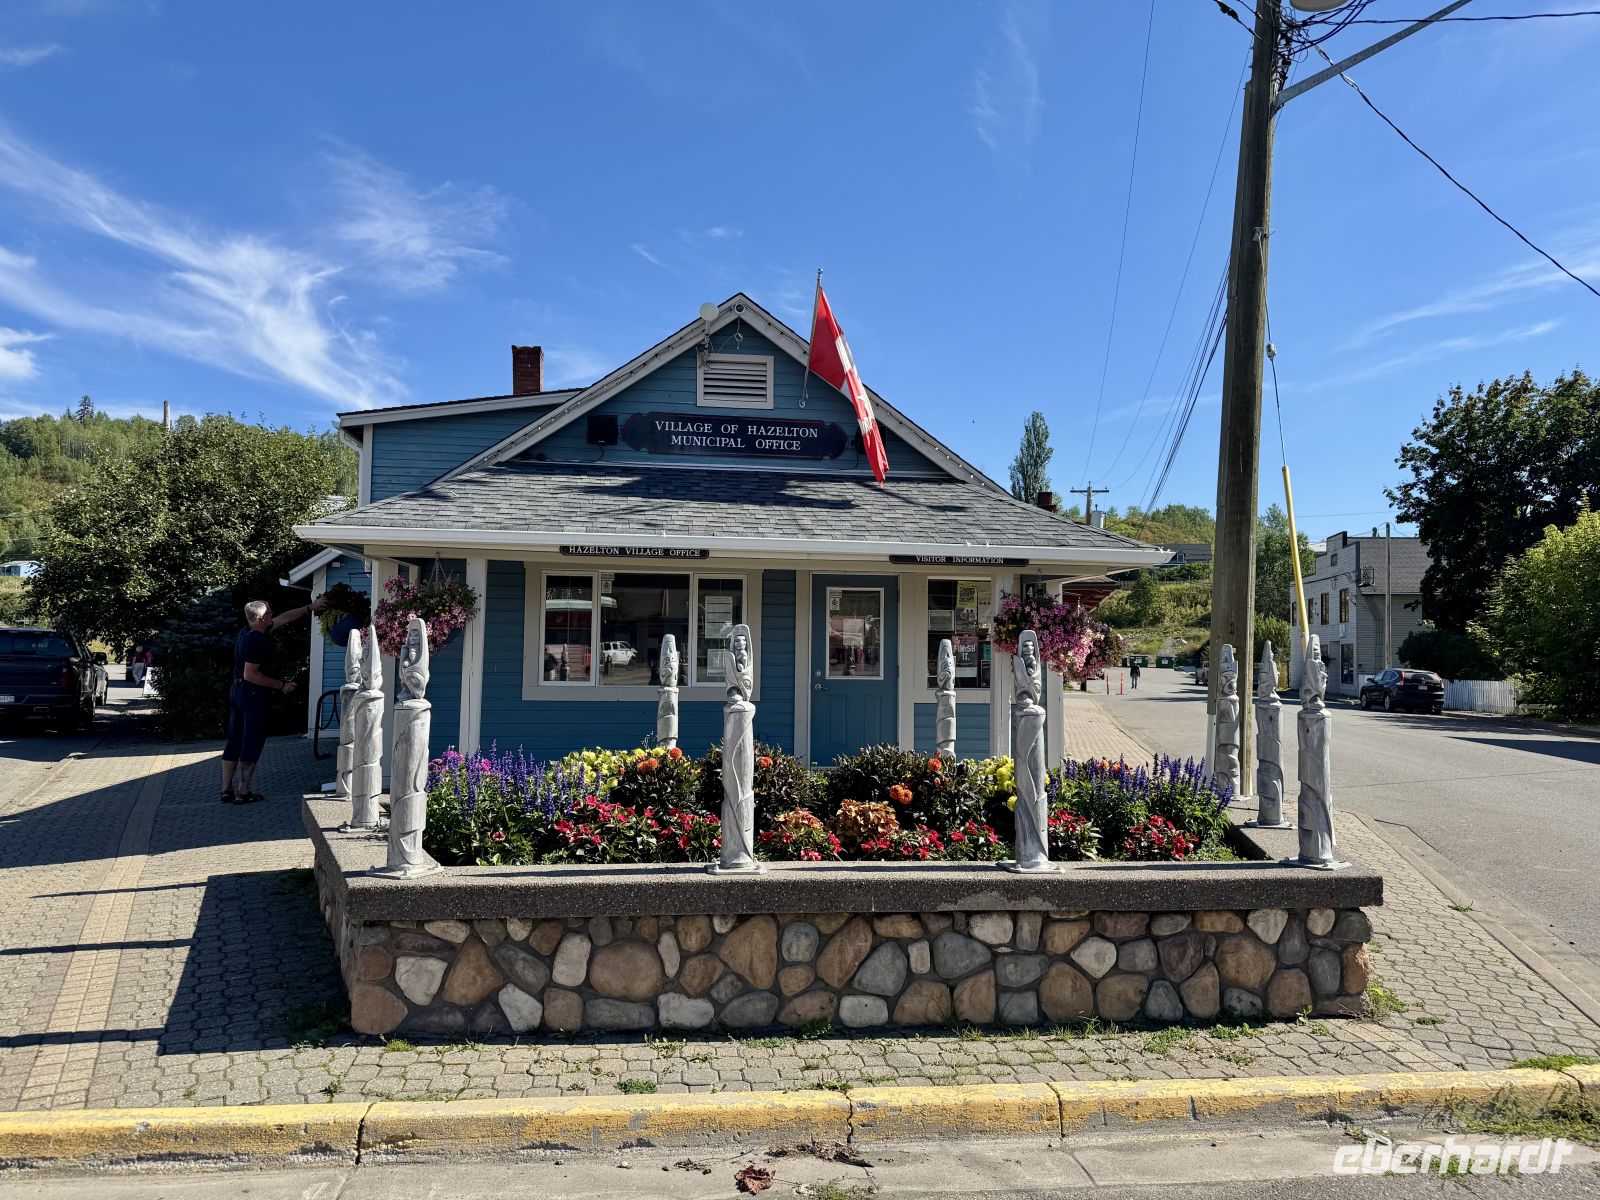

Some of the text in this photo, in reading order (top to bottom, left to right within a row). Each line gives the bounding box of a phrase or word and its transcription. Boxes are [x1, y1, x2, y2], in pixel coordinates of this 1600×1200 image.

[655, 420, 818, 438] VILLAGE OF HAZELTON
[671, 436, 801, 450] MUNICIPAL OFFICE
[569, 546, 700, 557] HAZELTON VILLAGE OFFICE
[916, 555, 1004, 564] VISITOR INFORMATION
